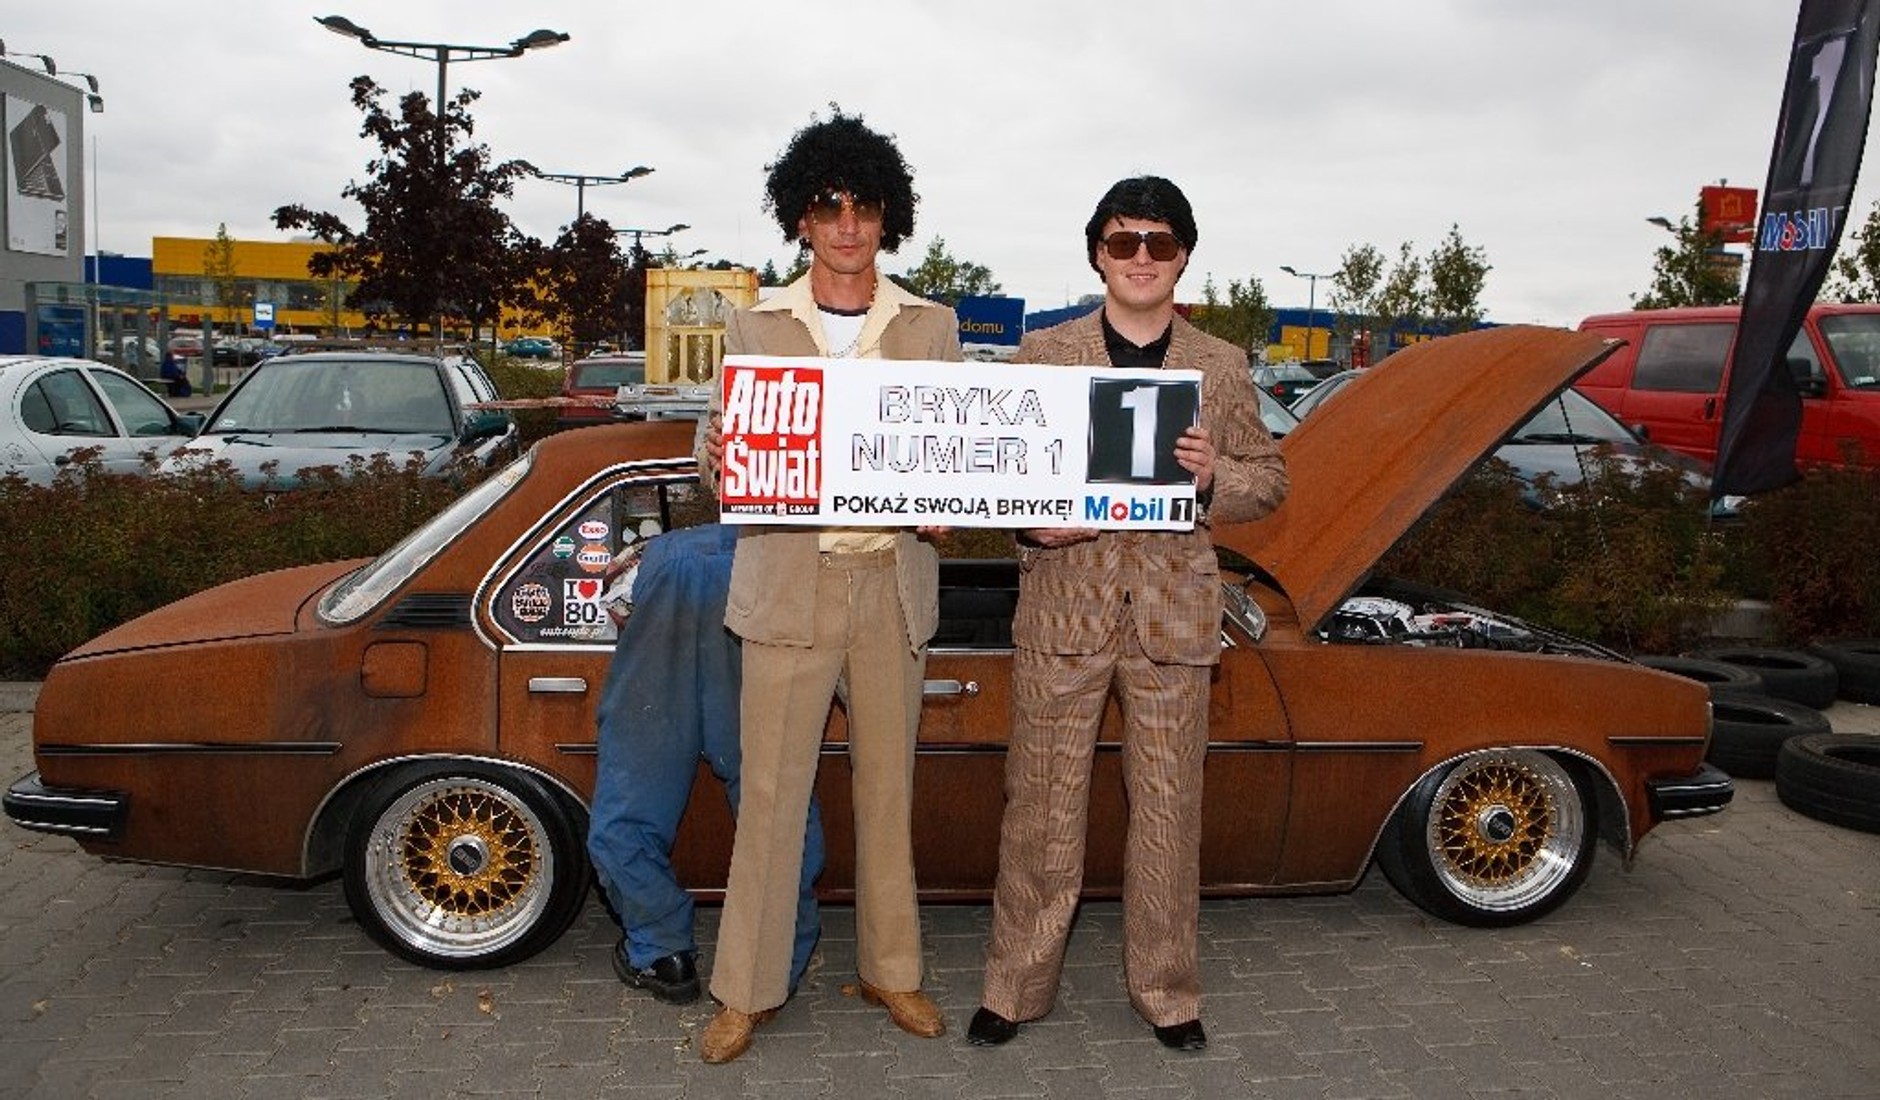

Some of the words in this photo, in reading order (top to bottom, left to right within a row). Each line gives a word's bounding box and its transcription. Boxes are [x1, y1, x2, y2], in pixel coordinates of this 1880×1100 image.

[1801, 36, 1847, 185] 1
[1761, 208, 1827, 250] Mobil
[961, 318, 1004, 334] domu
[722, 369, 820, 435] Auto
[879, 385, 1047, 427] BRYKA
[1120, 385, 1160, 478] 1
[725, 435, 820, 499] Świat
[852, 434, 1028, 475] NUMER
[1045, 438, 1063, 475] 1
[833, 492, 909, 514] POKAŻ
[914, 498, 991, 519] SWOJĄ
[997, 499, 1074, 521] BRYKĘ!
[1085, 496, 1164, 521] Mobil
[582, 525, 607, 534] Esso
[566, 580, 578, 599] I
